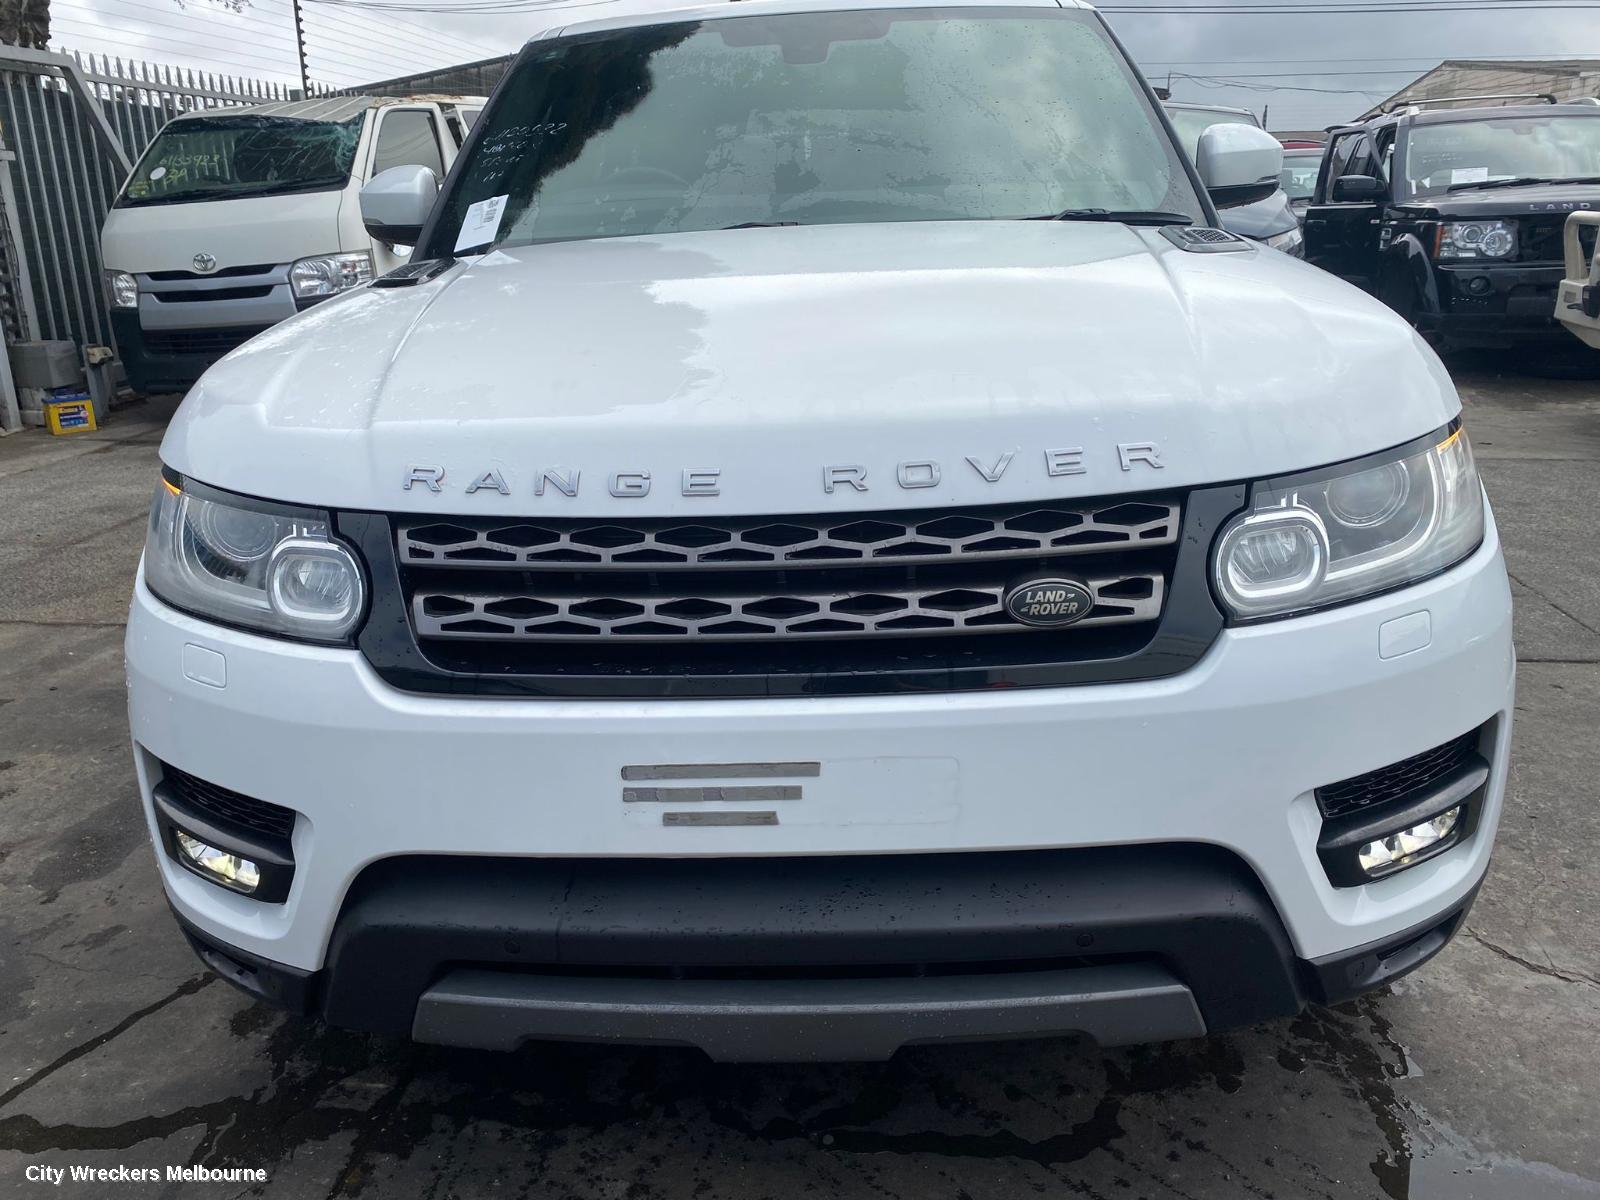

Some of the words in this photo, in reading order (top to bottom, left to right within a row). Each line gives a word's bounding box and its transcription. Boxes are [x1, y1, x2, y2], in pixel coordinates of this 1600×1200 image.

[1529, 202, 1591, 211] LAND
[403, 463, 721, 497] RANGE
[822, 441, 1165, 494] ROVER
